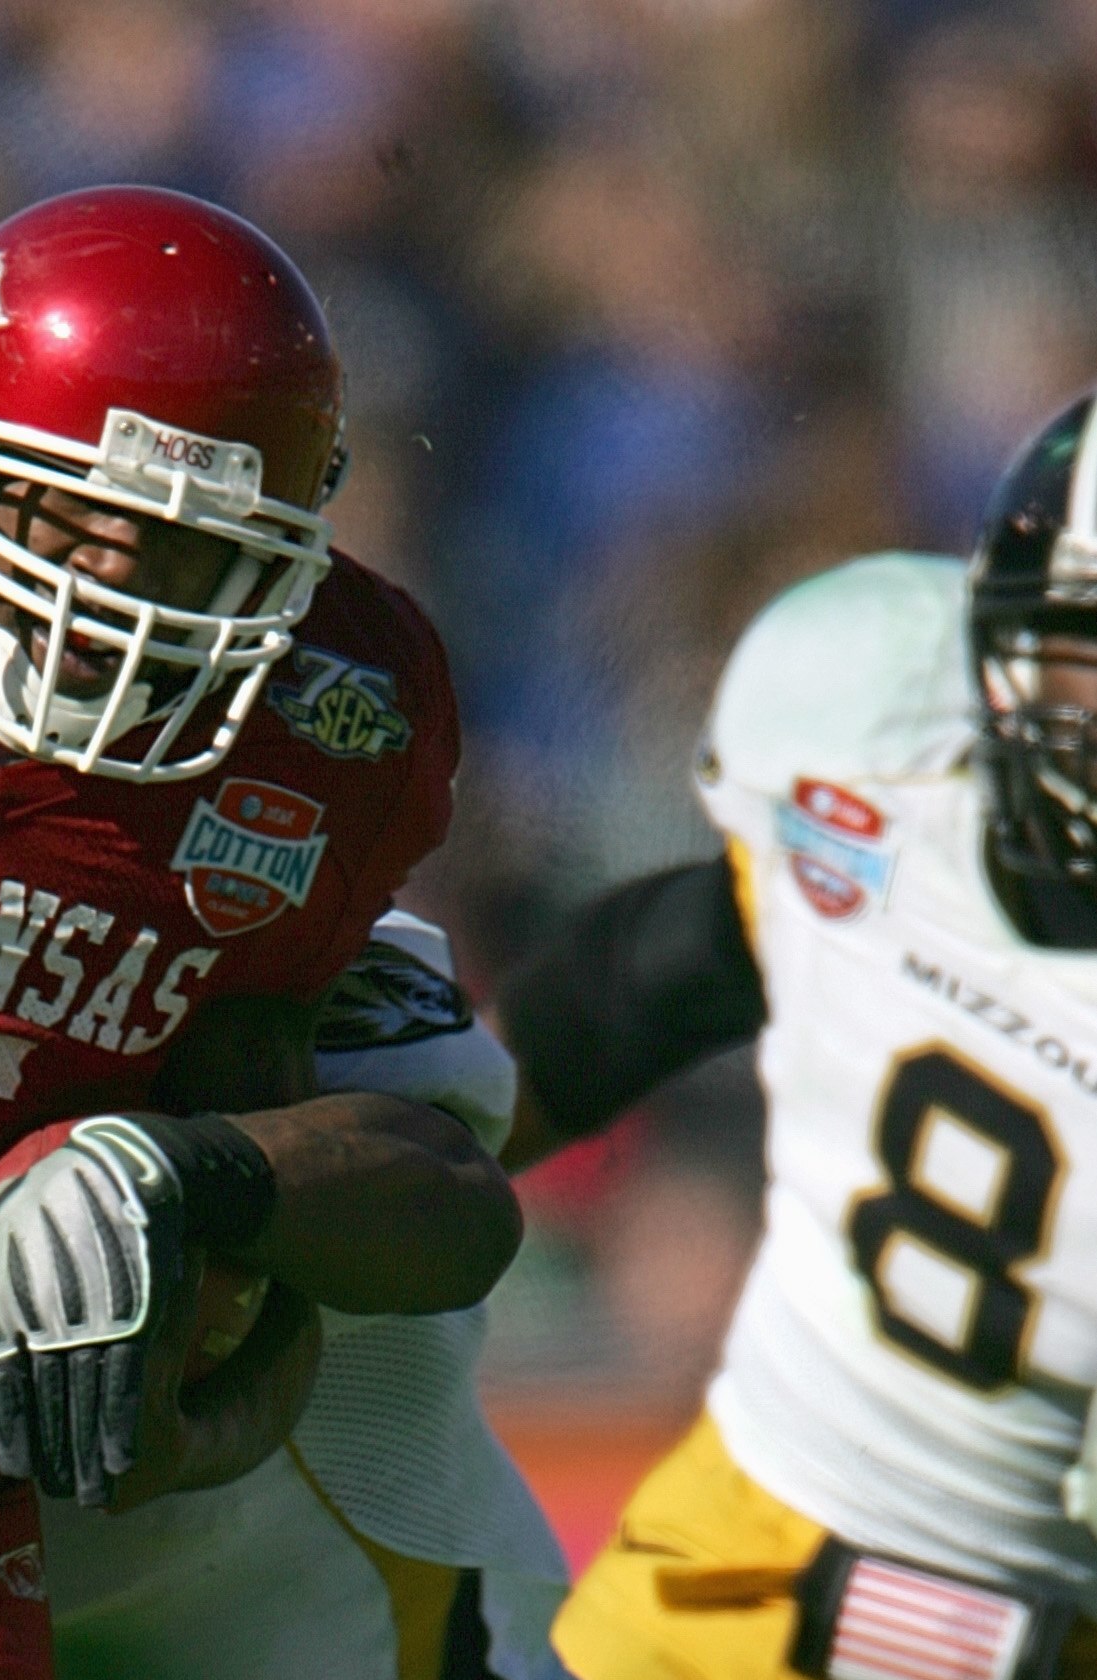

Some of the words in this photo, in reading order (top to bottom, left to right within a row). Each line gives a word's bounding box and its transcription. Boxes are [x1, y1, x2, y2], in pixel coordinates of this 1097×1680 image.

[152, 429, 216, 470] HOGS
[295, 648, 392, 754] 75
[314, 688, 374, 751] SEC
[184, 814, 316, 894] COTTON
[841, 1038, 1071, 1402] 8
